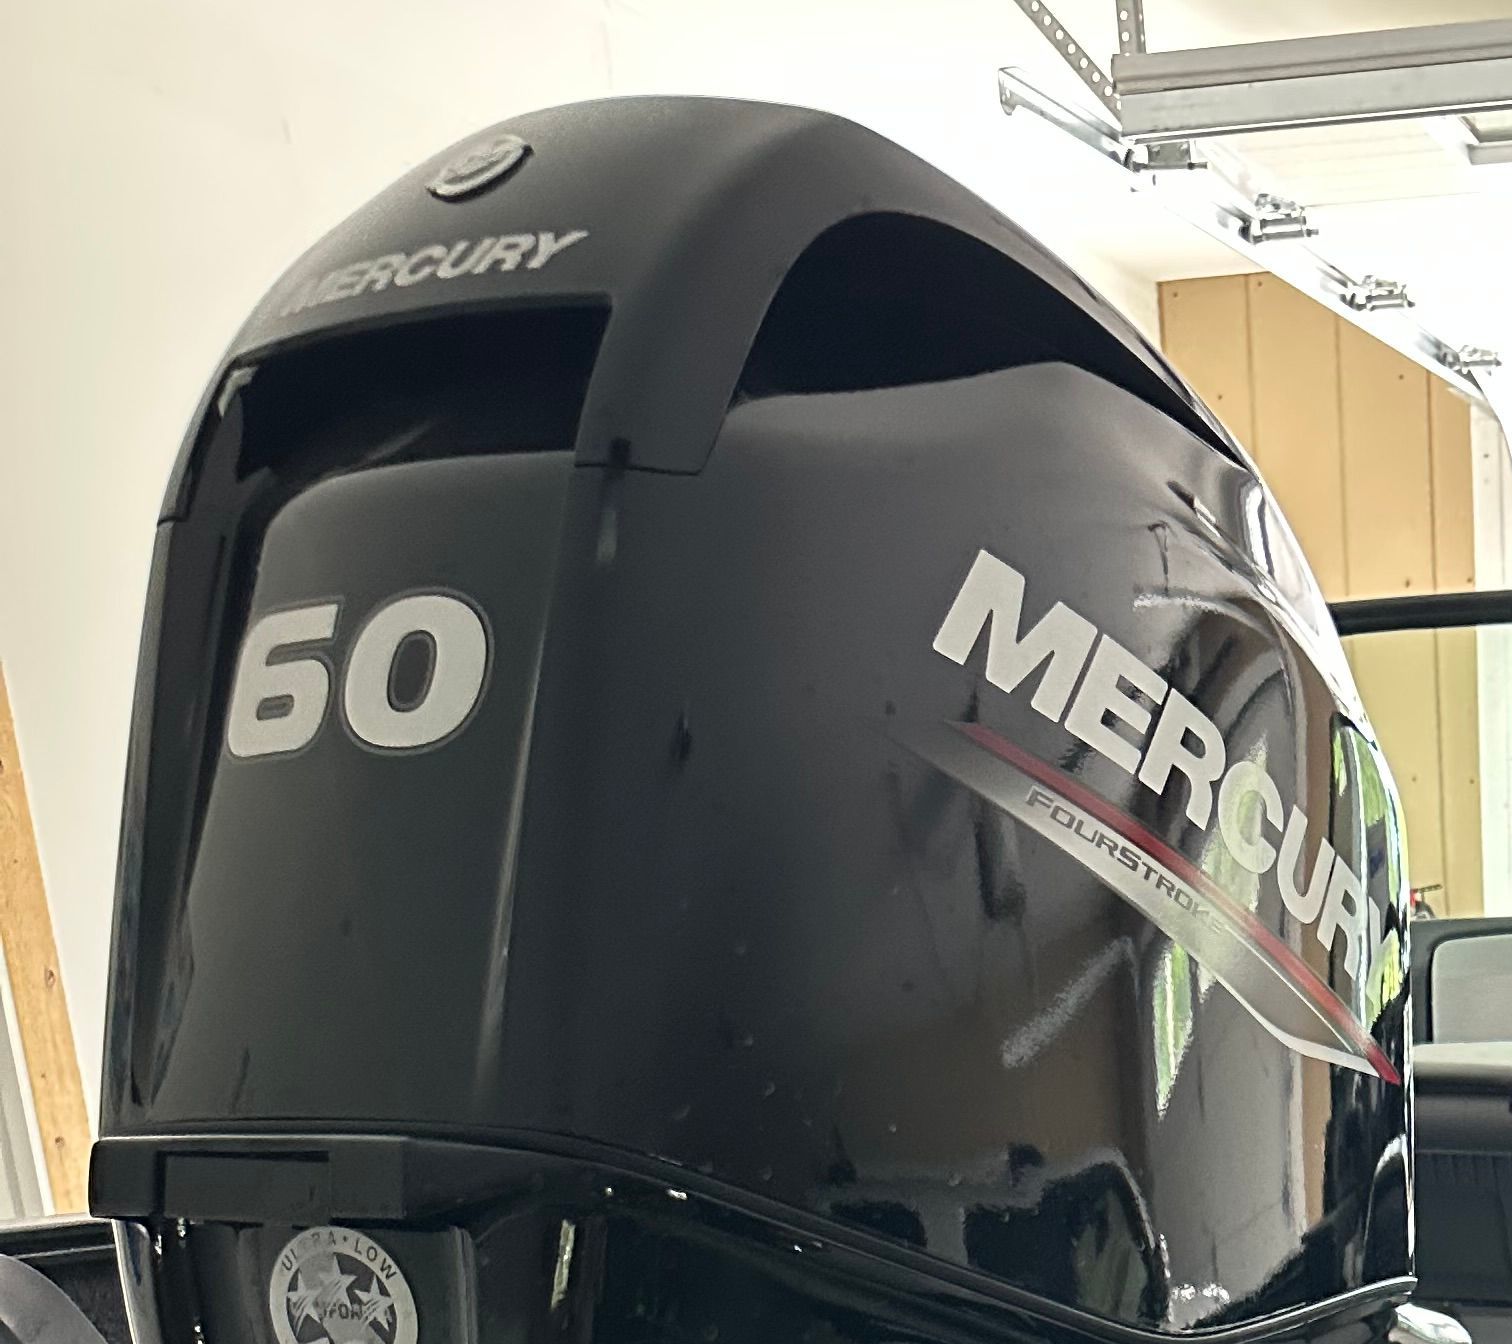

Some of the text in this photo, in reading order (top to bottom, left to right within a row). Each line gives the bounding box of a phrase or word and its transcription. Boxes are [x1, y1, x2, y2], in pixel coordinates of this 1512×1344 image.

[280, 230, 589, 317] MERCURY
[228, 594, 488, 758] 60
[932, 549, 1399, 1003] MERCURY
[1026, 785, 1226, 934] FOURSTROKE
[354, 1237, 397, 1281] LOW
